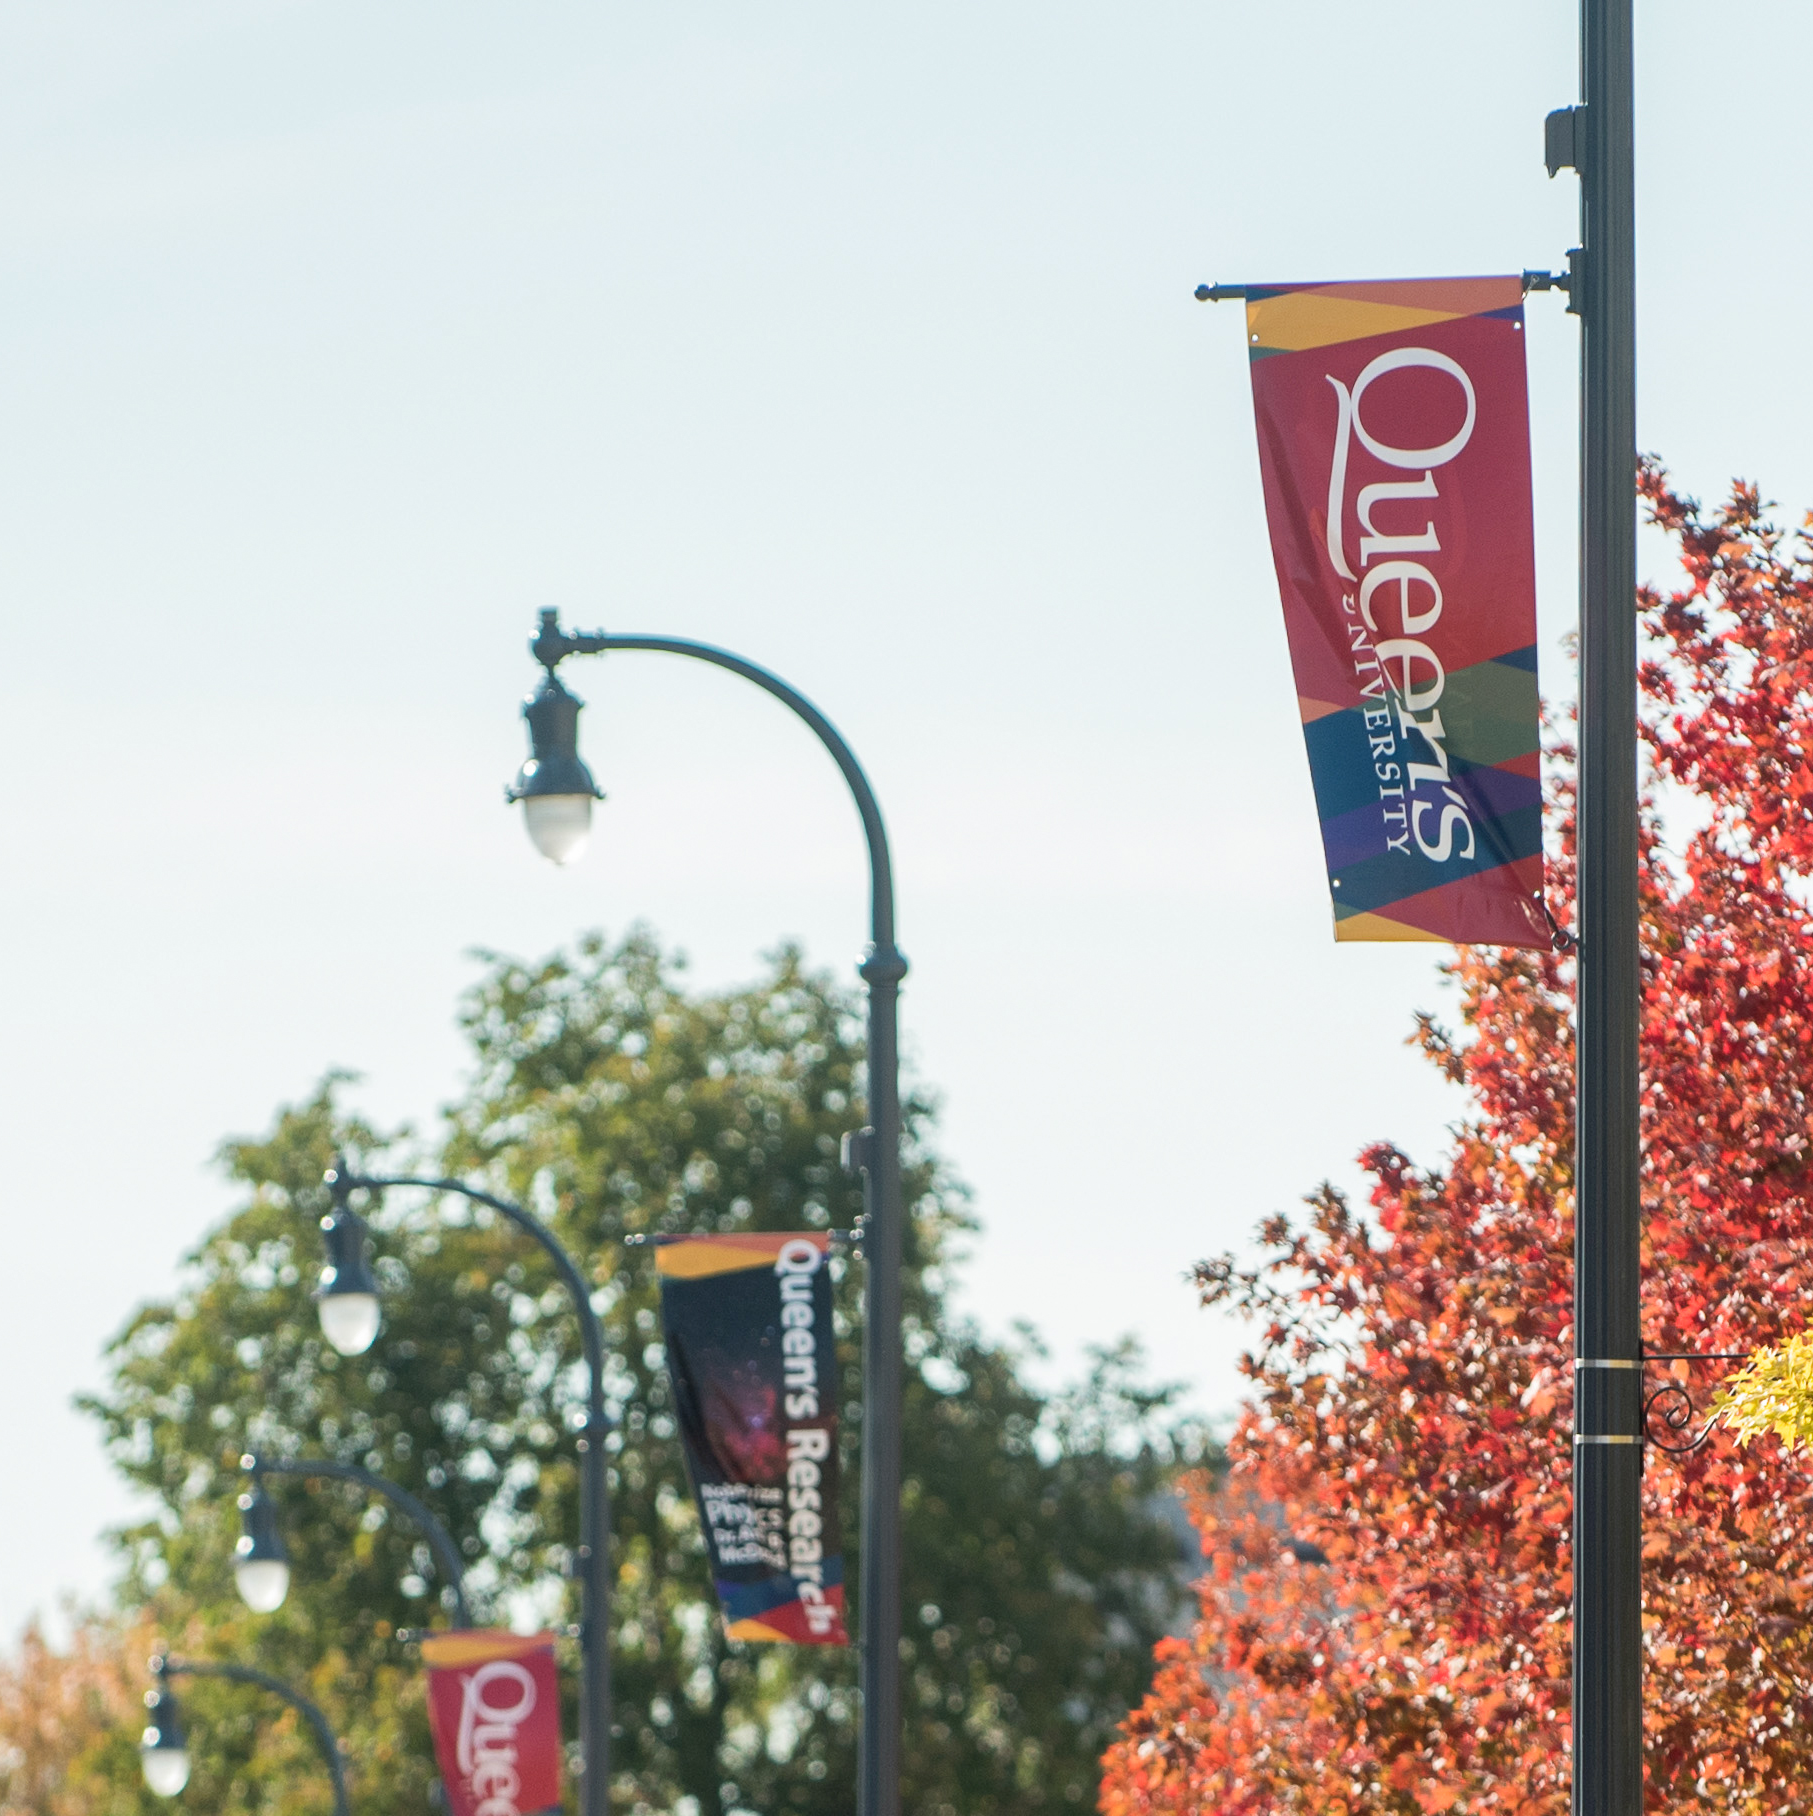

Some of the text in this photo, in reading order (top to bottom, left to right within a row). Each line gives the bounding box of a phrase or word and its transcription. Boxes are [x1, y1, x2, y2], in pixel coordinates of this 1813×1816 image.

[1325, 347, 1476, 862] Queen's
[1342, 595, 1410, 855] UNIVERSITY
[776, 1239, 838, 1635] Queen's Research
